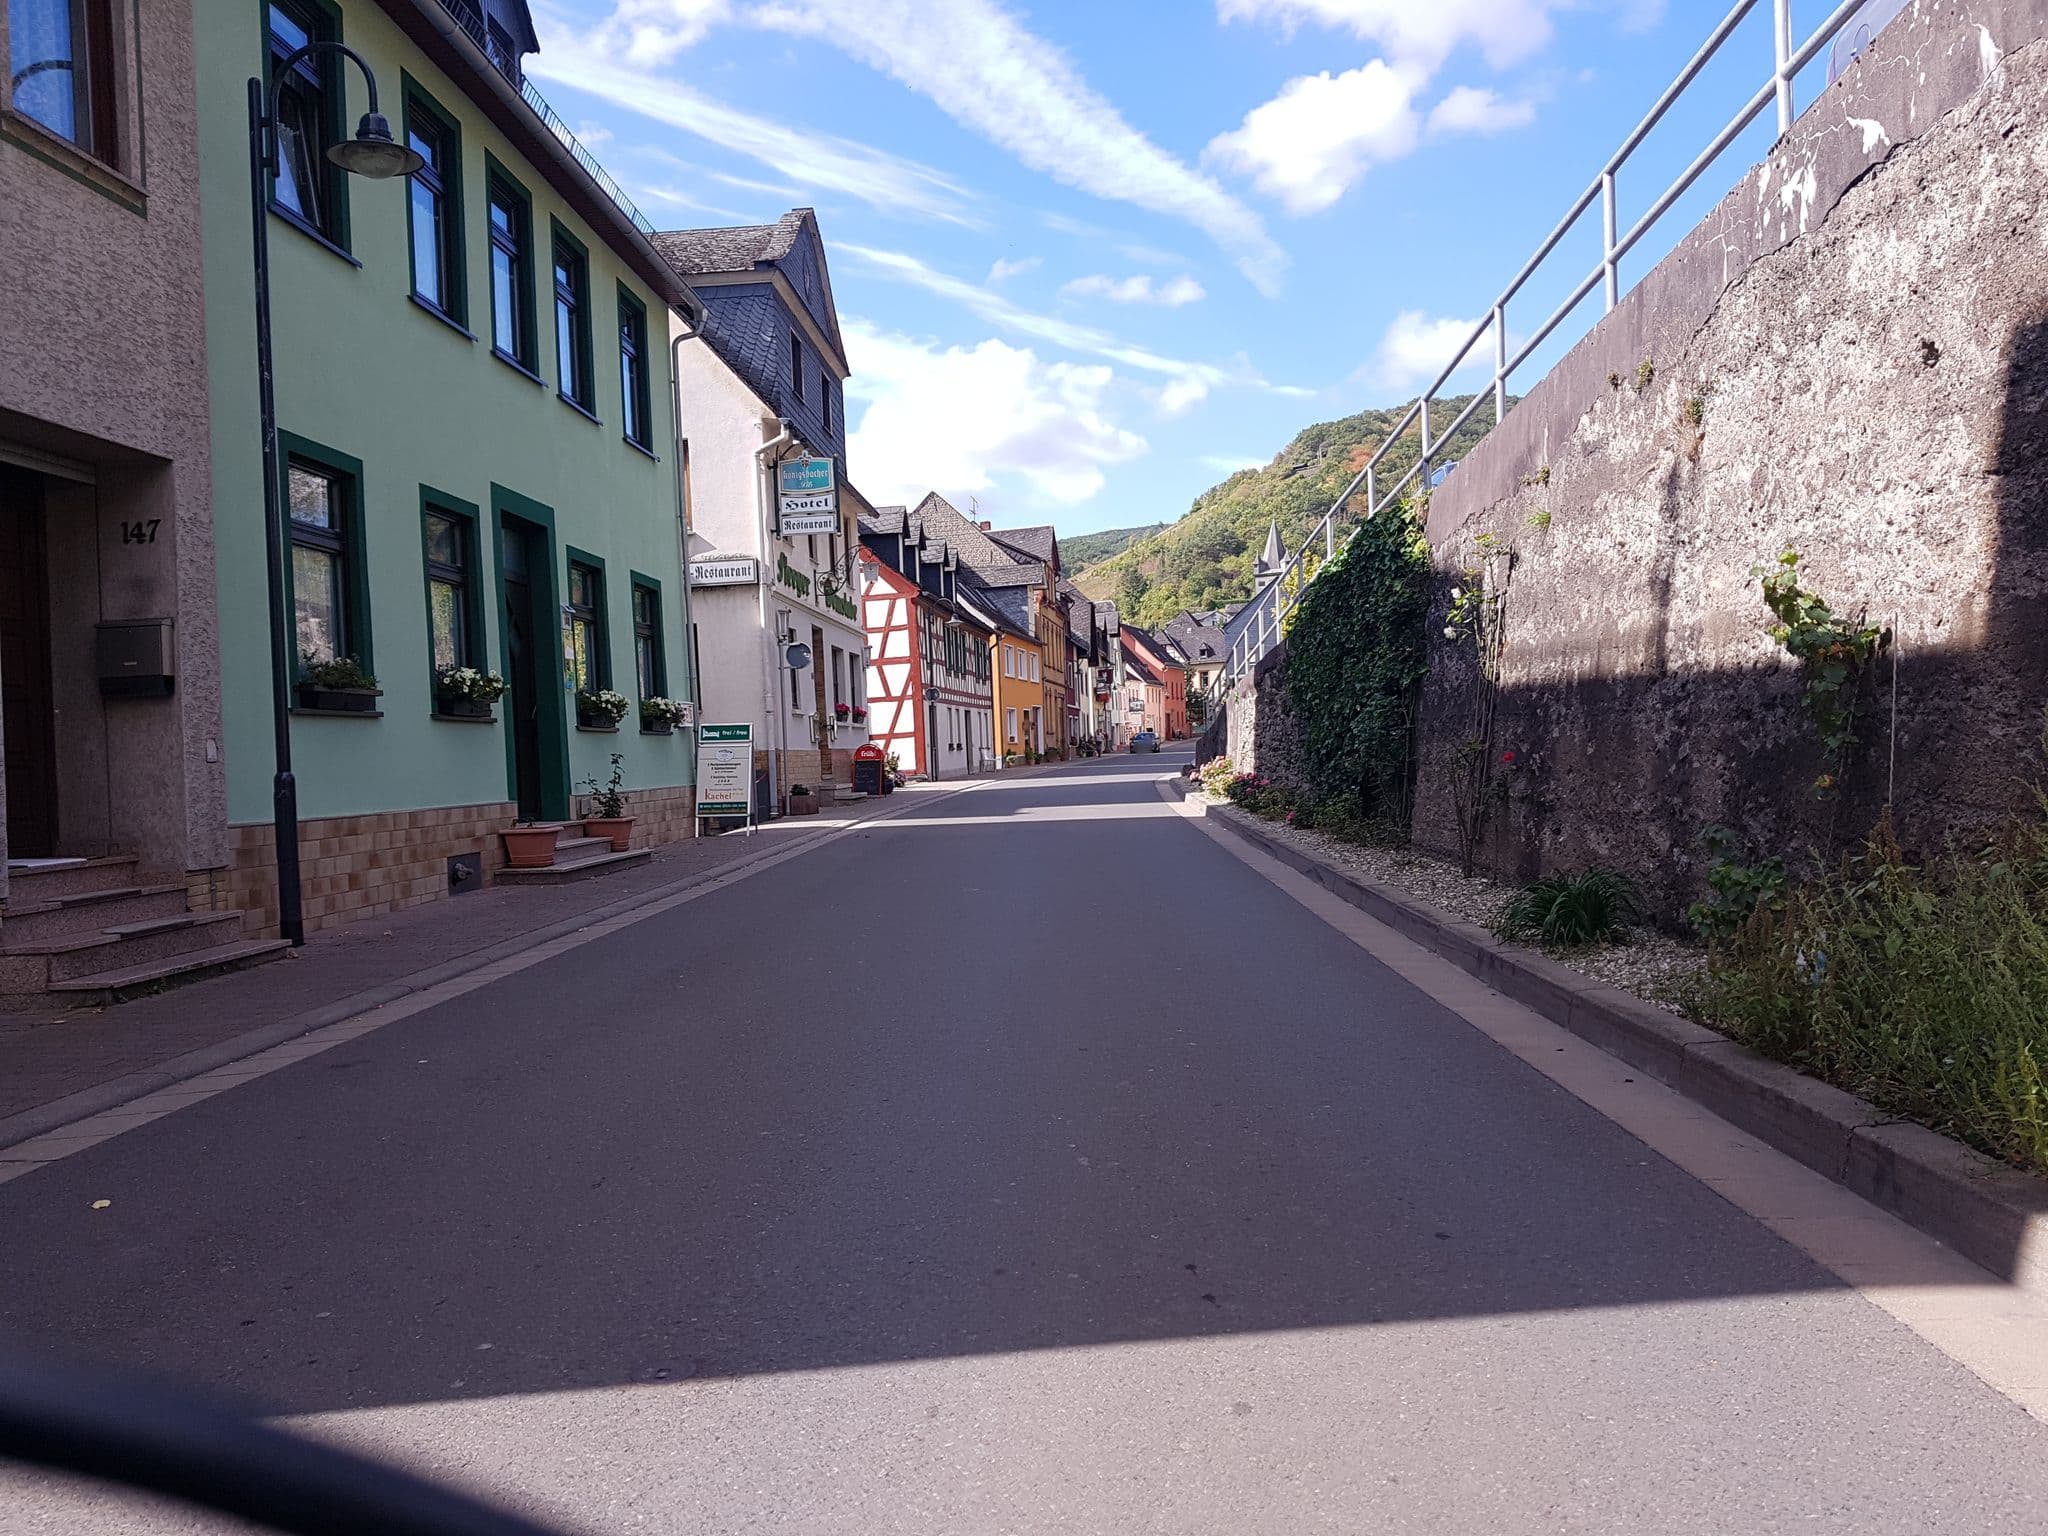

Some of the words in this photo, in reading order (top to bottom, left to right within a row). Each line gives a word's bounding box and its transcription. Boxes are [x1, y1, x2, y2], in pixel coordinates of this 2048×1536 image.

[785, 498, 829, 510] Hotel
[784, 520, 832, 530] Restaurant
[120, 519, 161, 544] 147
